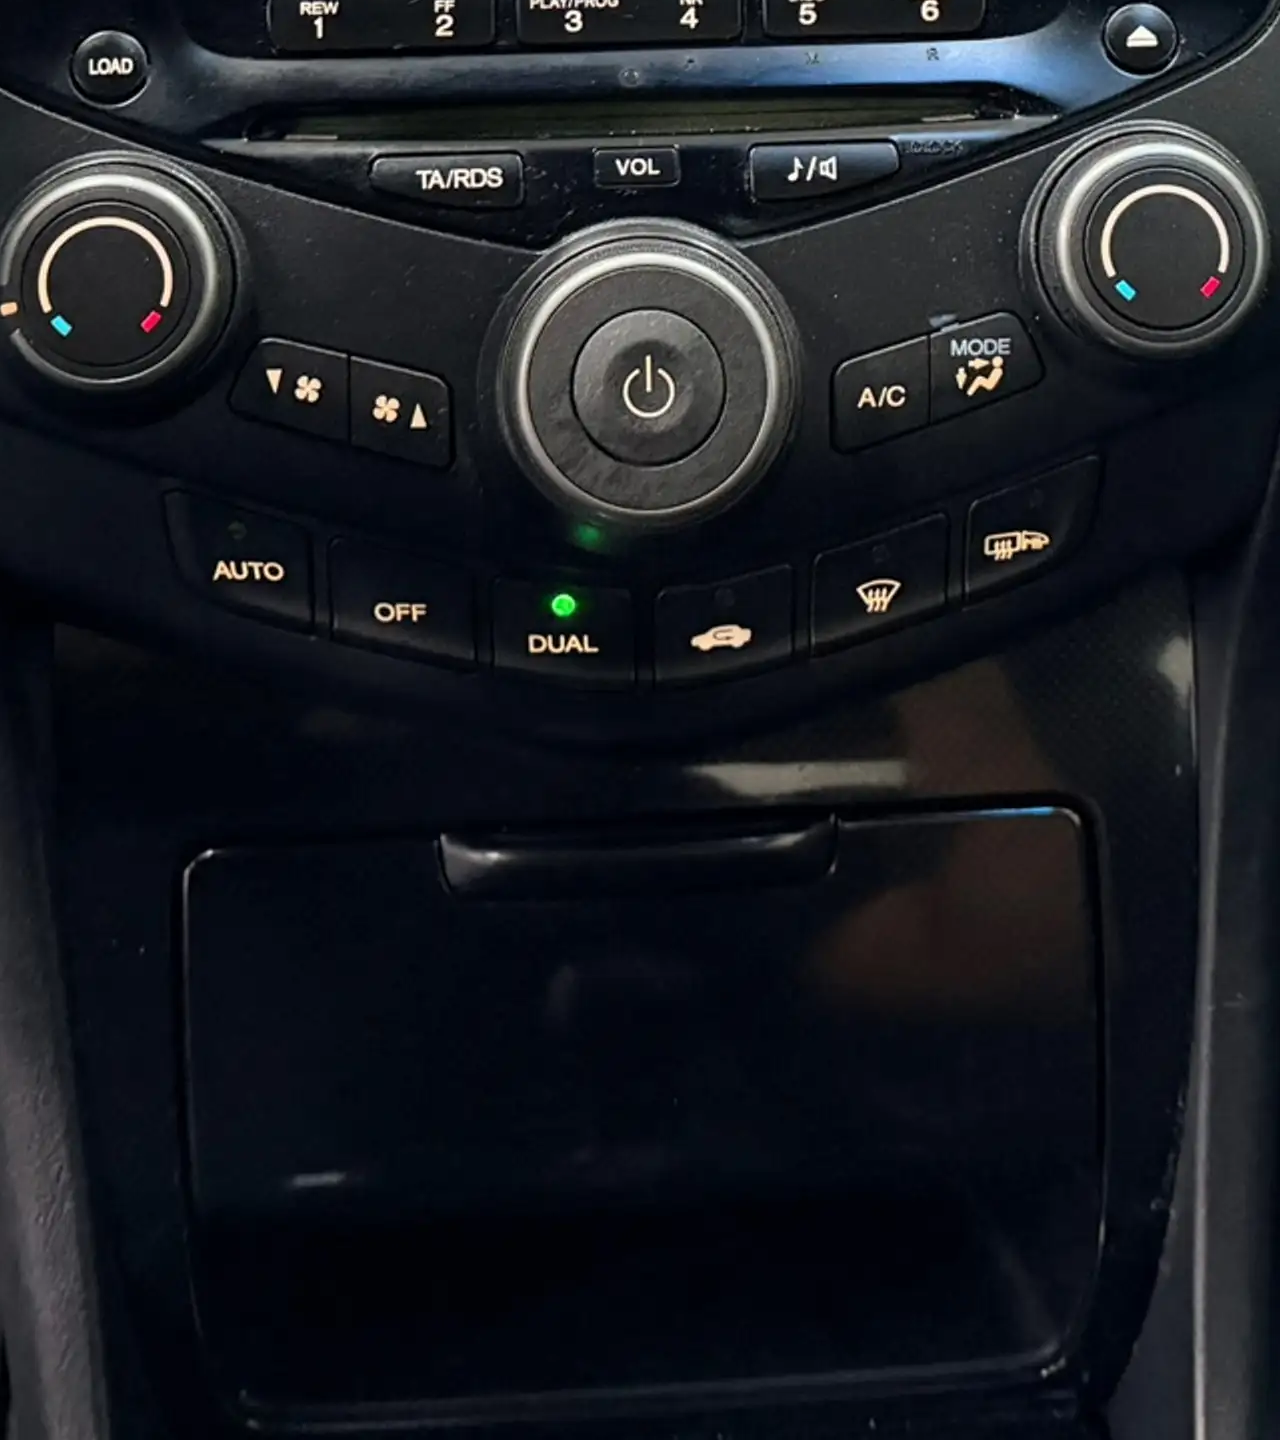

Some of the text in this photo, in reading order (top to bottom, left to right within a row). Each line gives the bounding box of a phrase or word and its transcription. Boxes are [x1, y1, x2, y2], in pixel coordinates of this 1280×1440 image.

[300, 1, 338, 16] REW
[434, 0, 455, 14] FF
[799, 4, 817, 25] 5
[921, 0, 939, 21] 6
[314, 17, 323, 38] 1
[436, 15, 453, 36] 2
[565, 11, 582, 32] 3
[680, 7, 698, 28] 4
[89, 58, 133, 75] LOAD
[616, 158, 660, 175] VOL
[416, 168, 503, 190] TA/RDS
[951, 338, 1010, 357] MODE
[858, 386, 905, 408] A/C
[214, 561, 284, 581] AUTO
[374, 603, 426, 621] OFF
[529, 635, 598, 653] DUAL
